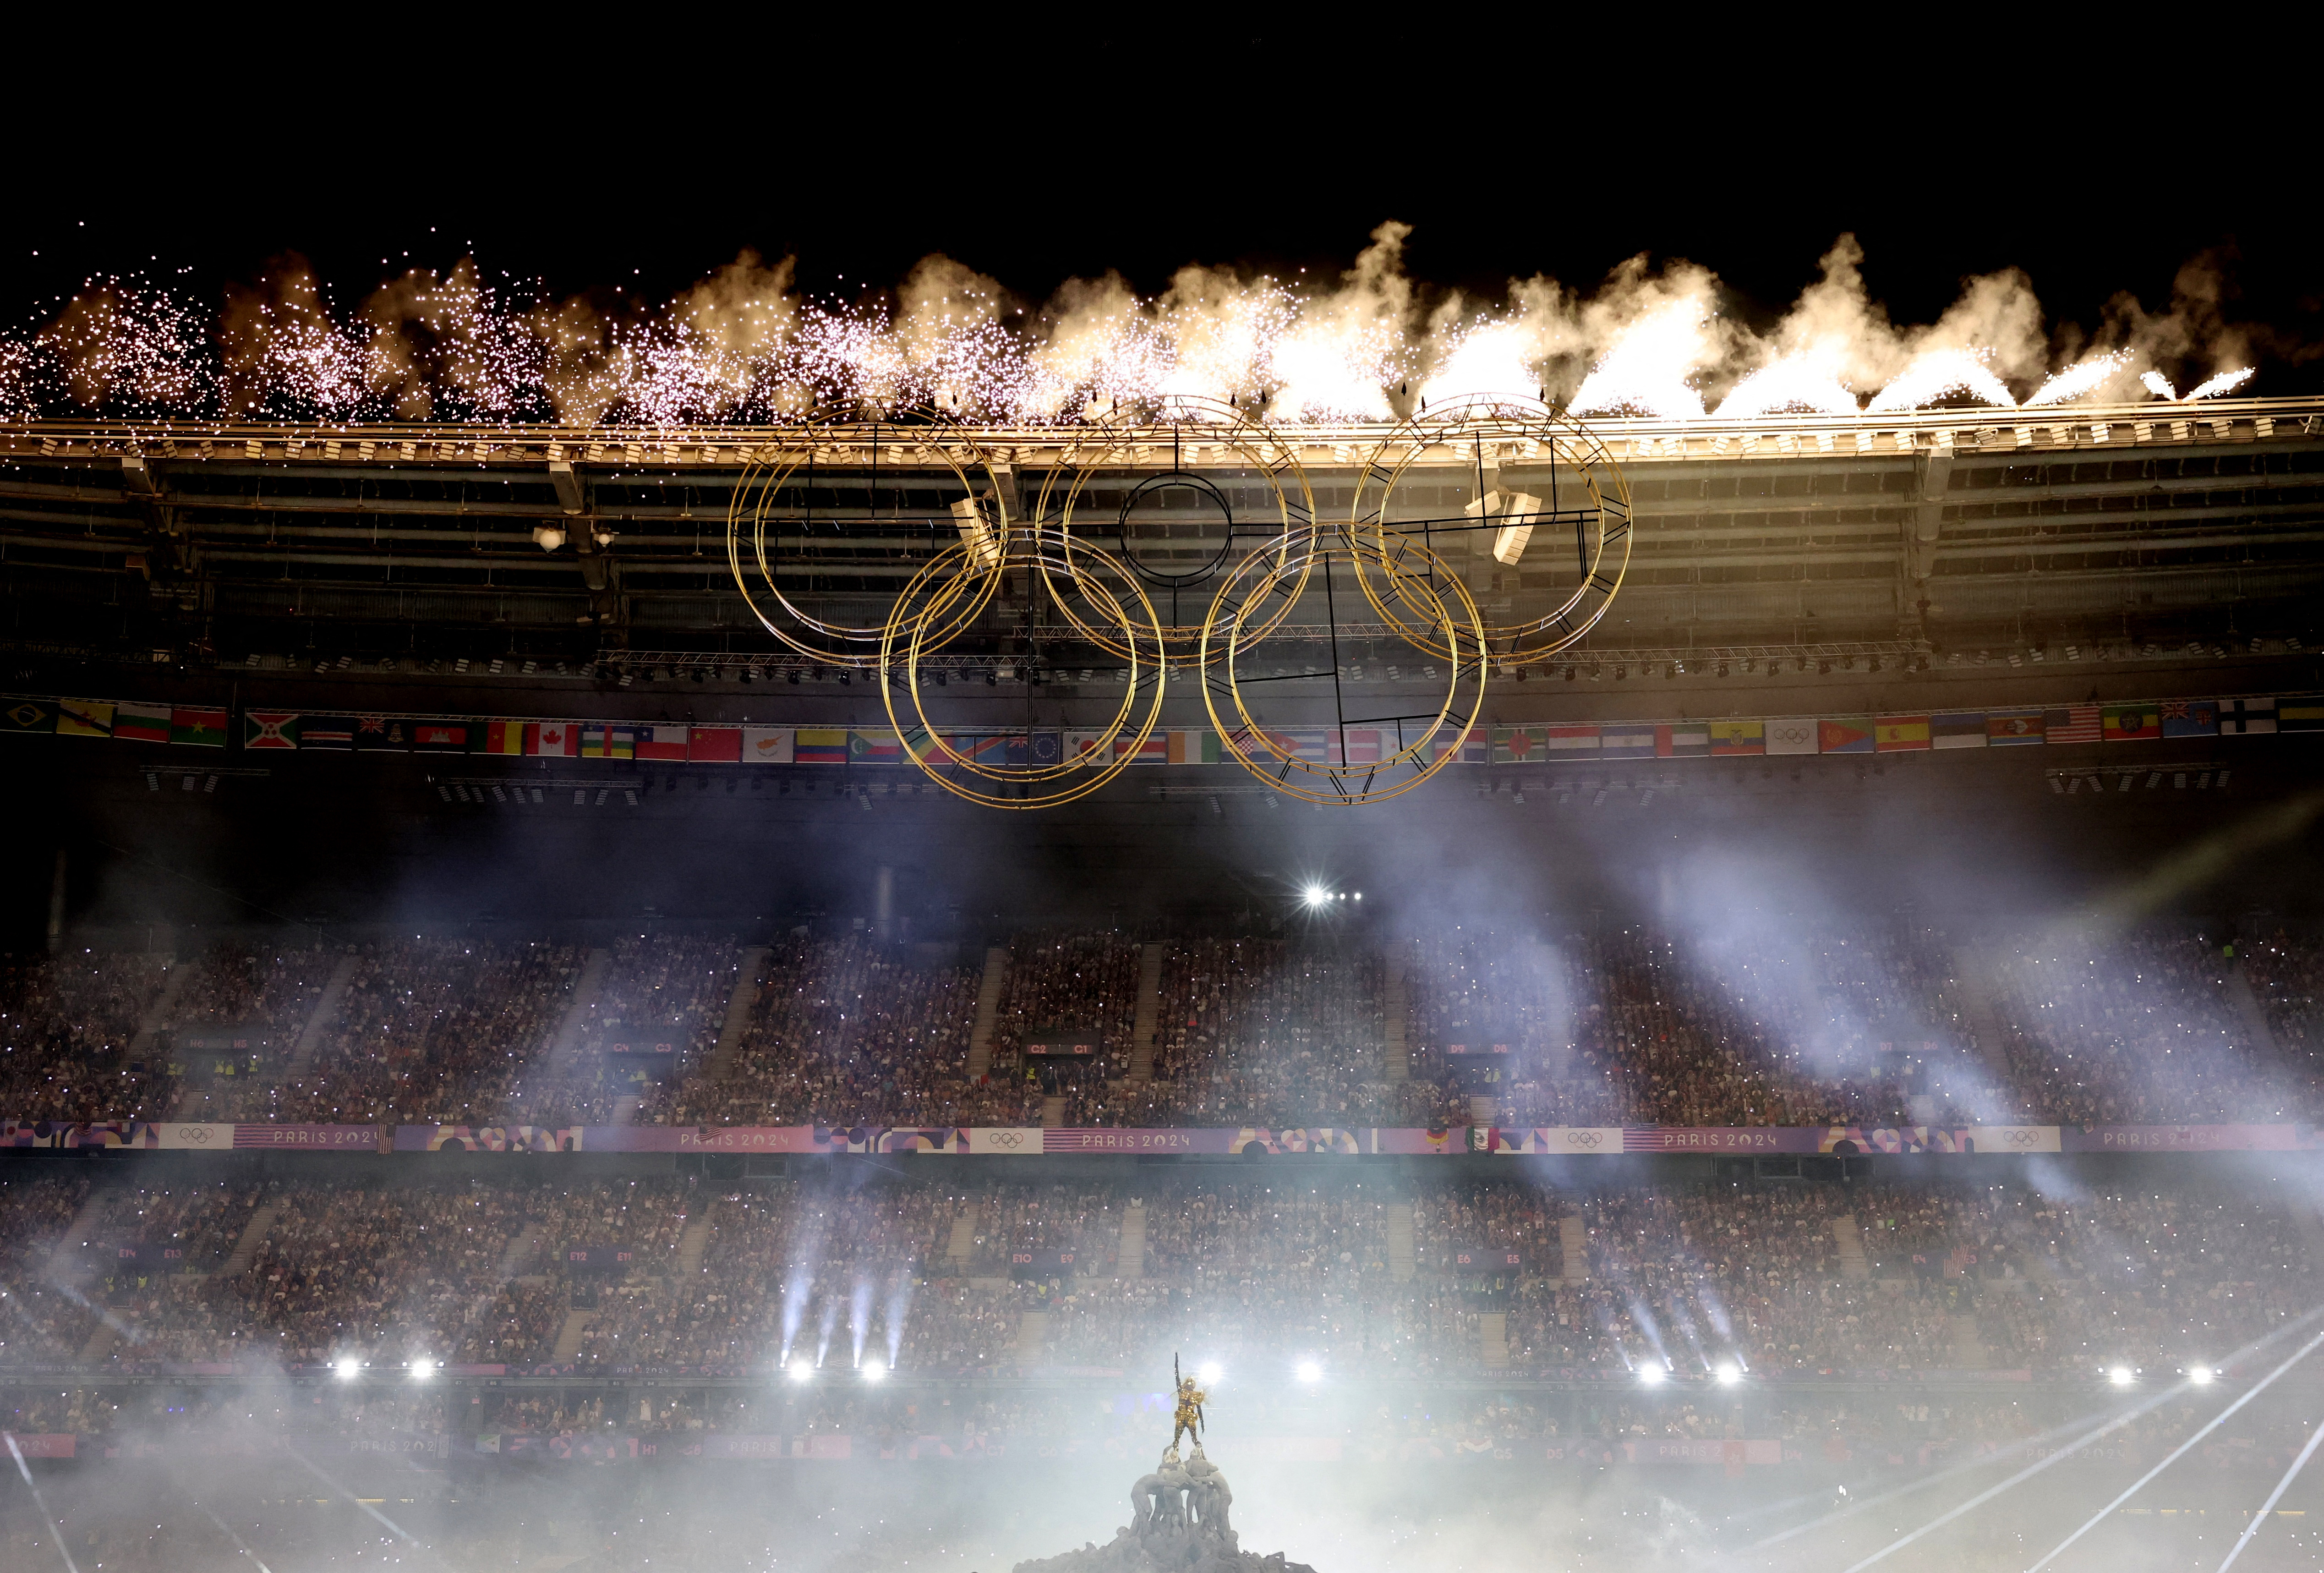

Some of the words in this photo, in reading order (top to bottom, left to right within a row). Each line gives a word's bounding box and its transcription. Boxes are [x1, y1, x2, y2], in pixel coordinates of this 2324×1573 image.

[1451, 1044, 1464, 1053] D9
[274, 1131, 327, 1143] PARIS
[742, 1134, 788, 1146] 2024
[1083, 1135, 1134, 1147] PARIS
[1143, 1135, 1189, 1147] 2024
[1665, 1134, 1719, 1146] PARIS
[1727, 1134, 1776, 1146] 2024
[2104, 1133, 2160, 1145] PARIS
[164, 1249, 181, 1258] E13
[569, 1252, 586, 1261] E12
[617, 1252, 632, 1261] E11
[1012, 1254, 1032, 1263] E10
[1061, 1254, 1074, 1263] E9
[1457, 1255, 1471, 1264] E6
[1507, 1255, 1520, 1264] E5
[1913, 1255, 1926, 1263] E4
[351, 1440, 396, 1452] PARIS
[642, 1444, 657, 1455] H1
[730, 1442, 776, 1452] PARIS
[1547, 1448, 1564, 1459] D5
[1660, 1446, 1706, 1457] PARIS
[2081, 1448, 2126, 1459] 2024
